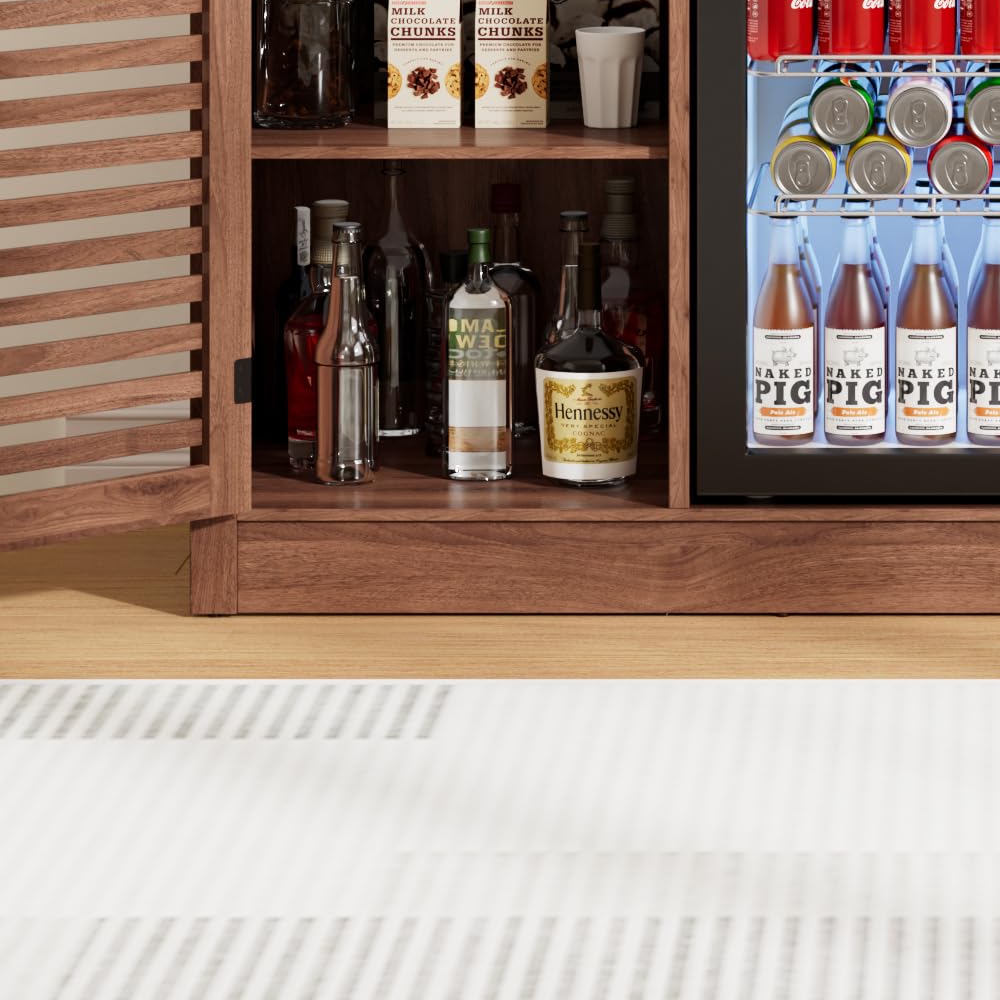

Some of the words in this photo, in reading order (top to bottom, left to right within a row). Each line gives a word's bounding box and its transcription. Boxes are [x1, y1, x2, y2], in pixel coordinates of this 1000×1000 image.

[391, 7, 425, 15] MILK
[478, 7, 513, 15] MILK
[390, 27, 456, 36] CHUNKS
[477, 27, 543, 36] CHUNKS
[755, 366, 811, 378] NAKED
[826, 366, 882, 378] NAKED
[898, 366, 954, 378] NAKED
[755, 379, 811, 405] PIG
[826, 379, 882, 405] PIG
[898, 379, 954, 405] PIG
[554, 402, 623, 422] Hennessy
